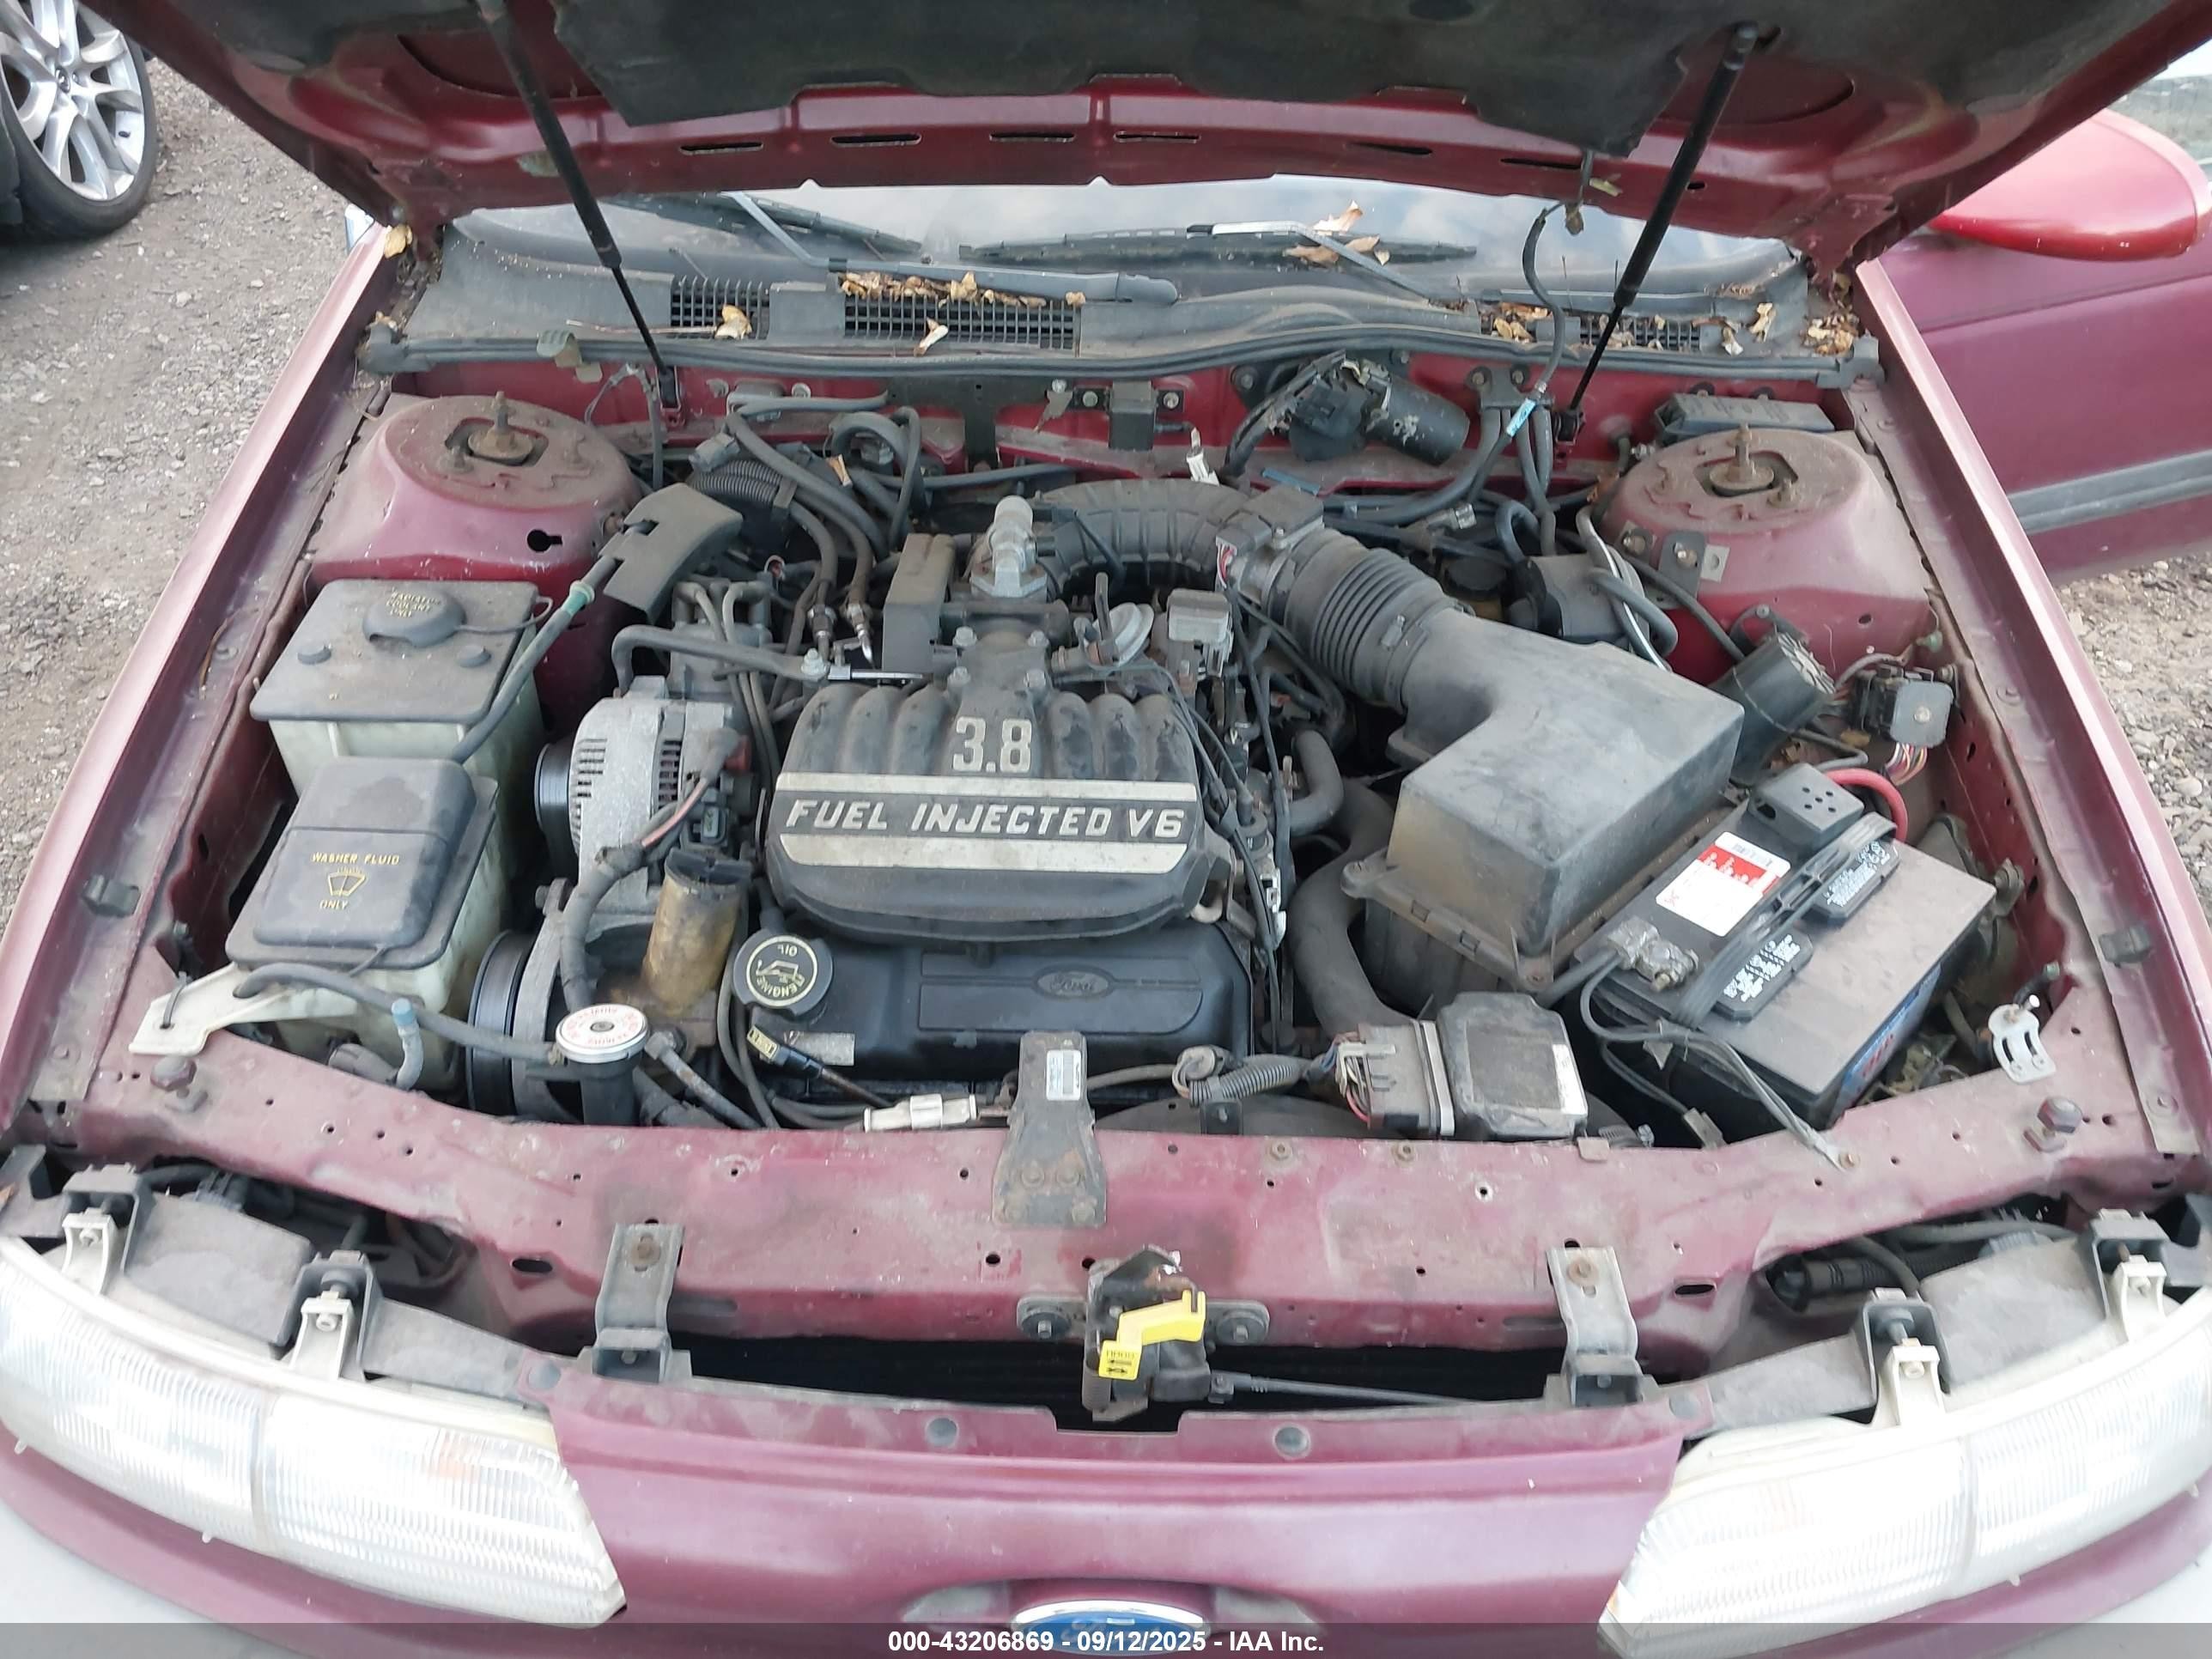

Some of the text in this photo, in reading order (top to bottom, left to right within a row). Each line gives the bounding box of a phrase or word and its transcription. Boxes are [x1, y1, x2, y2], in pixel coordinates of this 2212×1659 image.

[953, 716, 1032, 773] 3.8
[785, 799, 1185, 838] FUEL INJECTED V6
[312, 852, 400, 866] WASHER FLUID
[319, 899, 349, 910] ONLY
[777, 944, 799, 957] OIL
[756, 975, 799, 998] ENGINE
